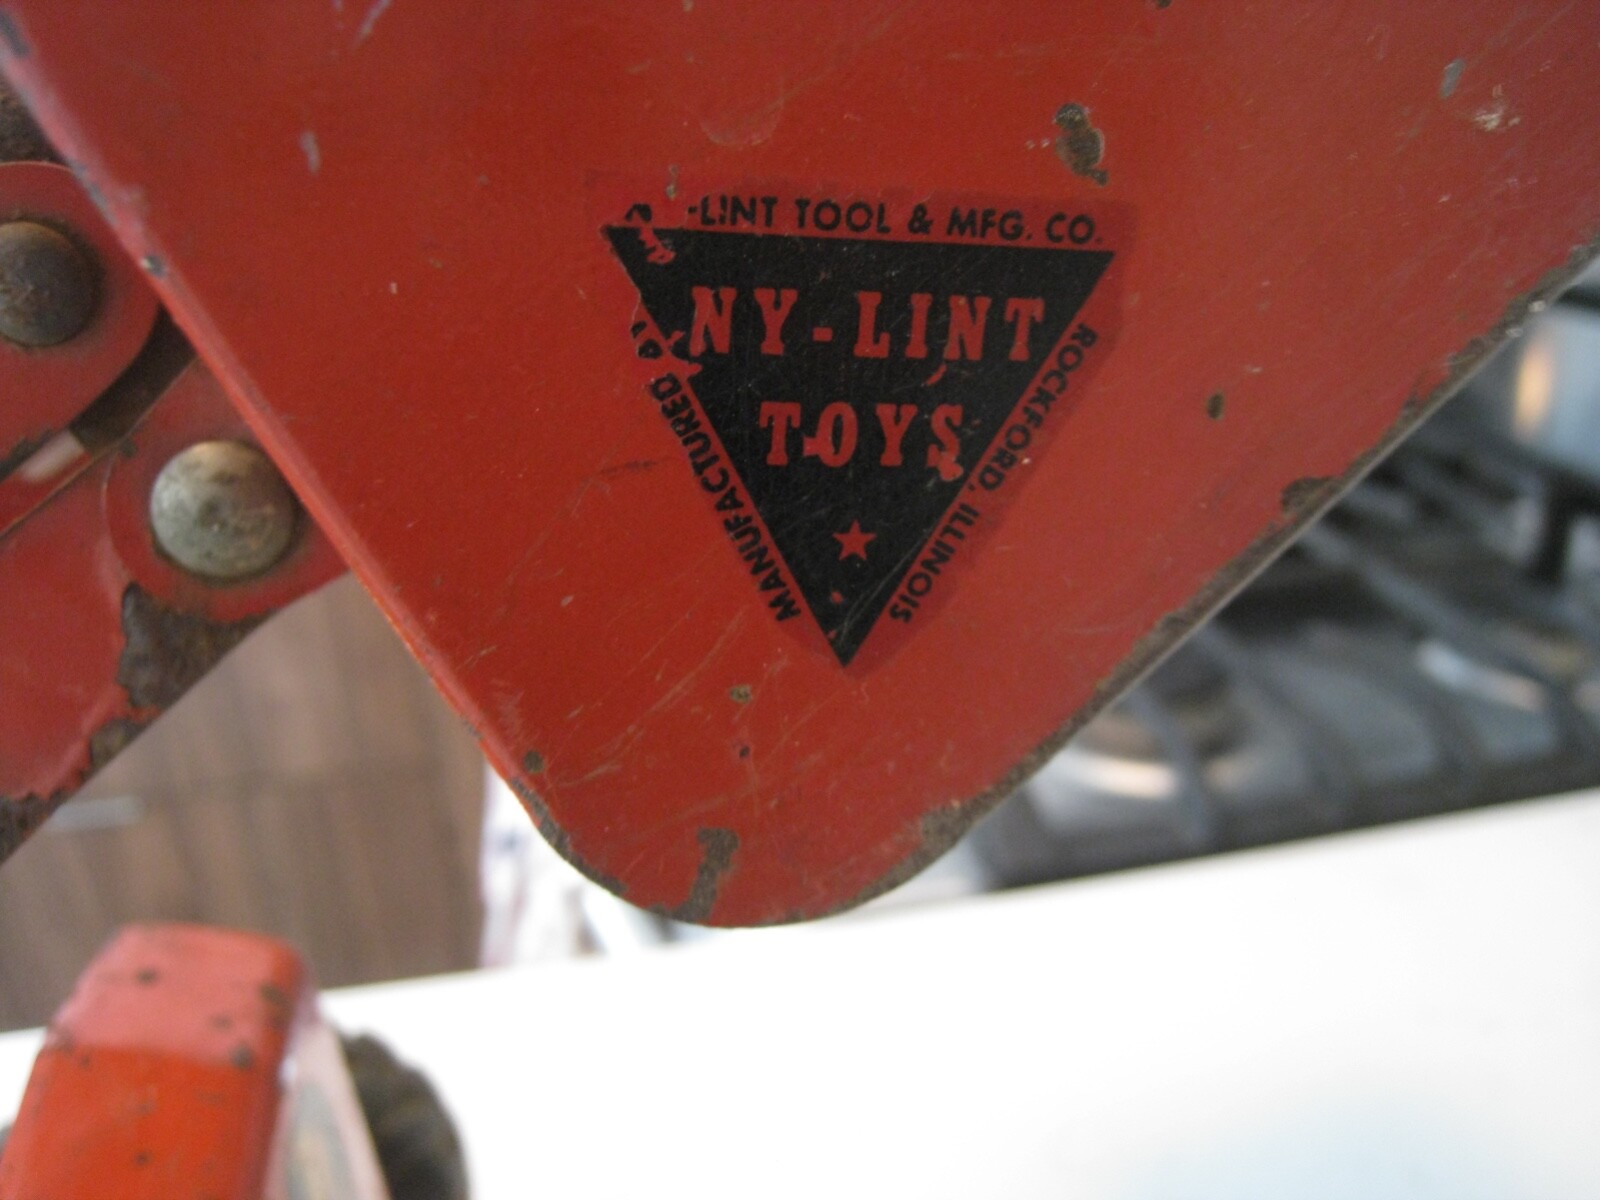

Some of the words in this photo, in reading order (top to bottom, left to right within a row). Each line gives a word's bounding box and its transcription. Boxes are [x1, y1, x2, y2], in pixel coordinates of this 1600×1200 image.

[795, 198, 892, 234] TOOL
[908, 203, 934, 235] &
[947, 206, 1033, 241] MFG.
[1045, 212, 1103, 244] CO.
[758, 402, 964, 474] TOYS
[966, 322, 1098, 491] ROCKFORD,
[650, 372, 801, 622] MANUFACTURED
[889, 503, 980, 624] ILLINOIS
